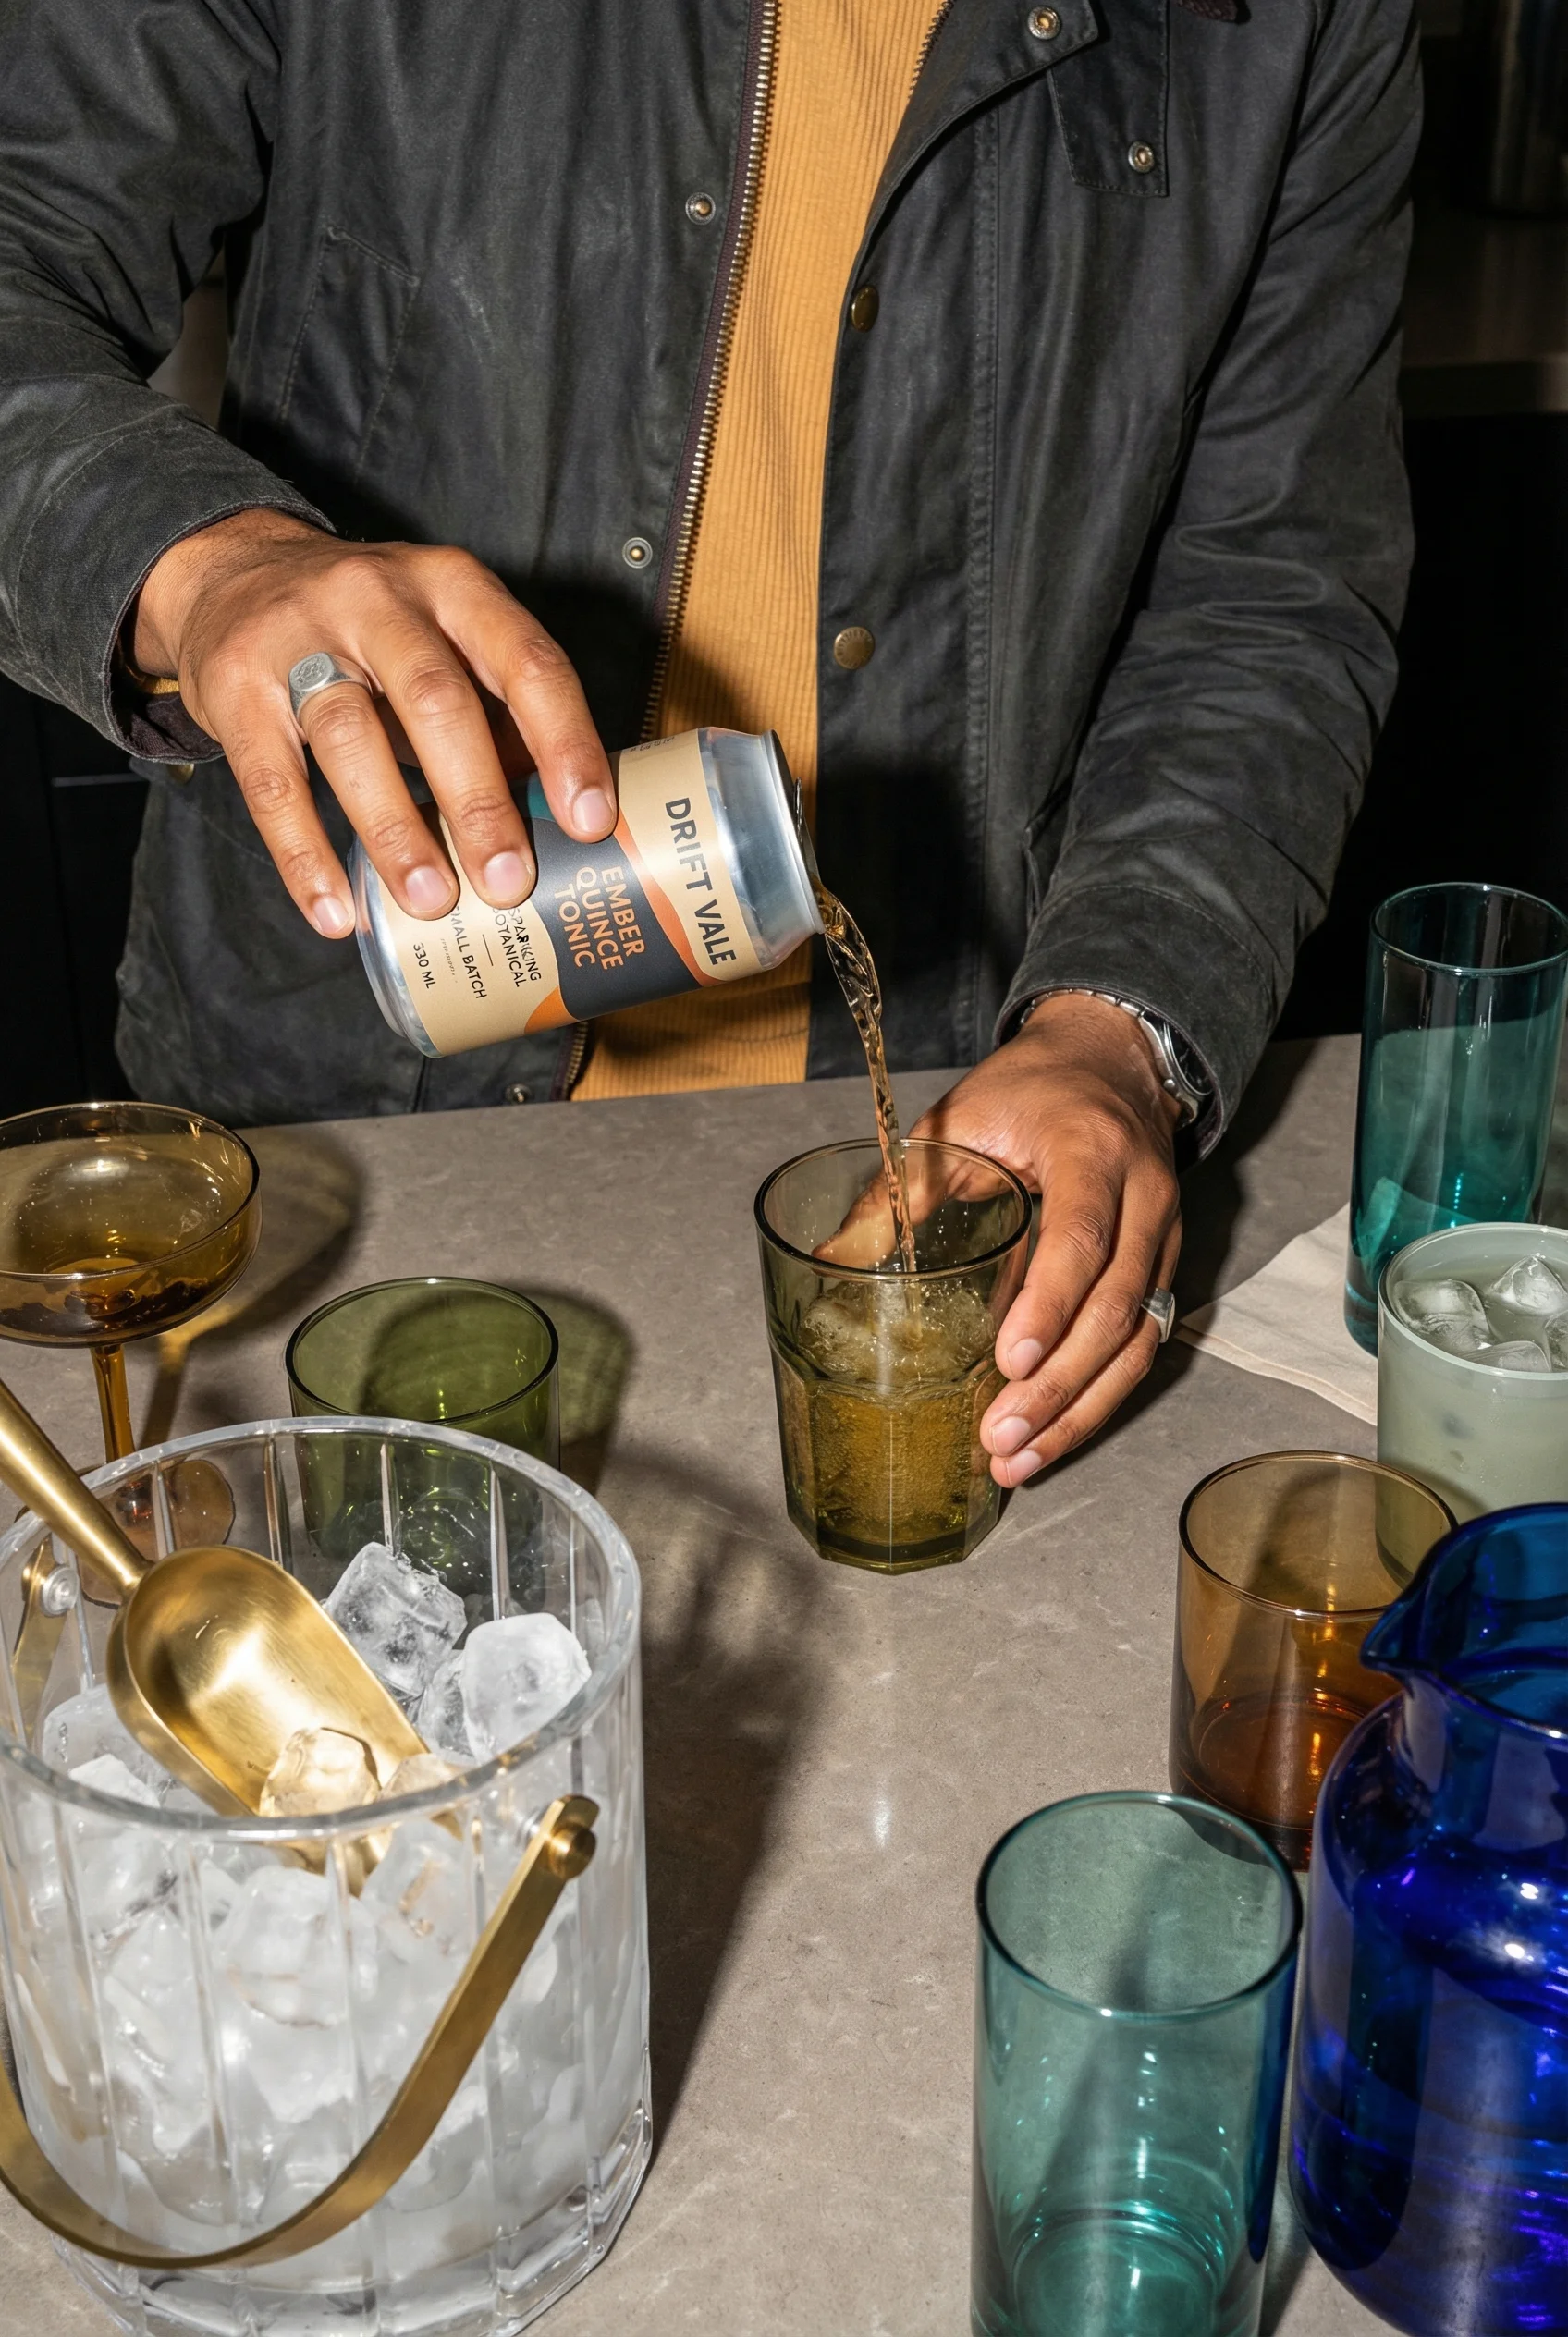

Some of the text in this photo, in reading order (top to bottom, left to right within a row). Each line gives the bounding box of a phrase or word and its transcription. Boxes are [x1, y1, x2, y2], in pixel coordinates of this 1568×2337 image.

[554, 883, 596, 968] TONIC
[576, 867, 624, 970] QUINCE
[601, 866, 645, 957] EMBER
[666, 798, 736, 965] DRIFT VALE
[413, 942, 435, 989] 330 ML
[450, 906, 487, 998] MALL BATCH
